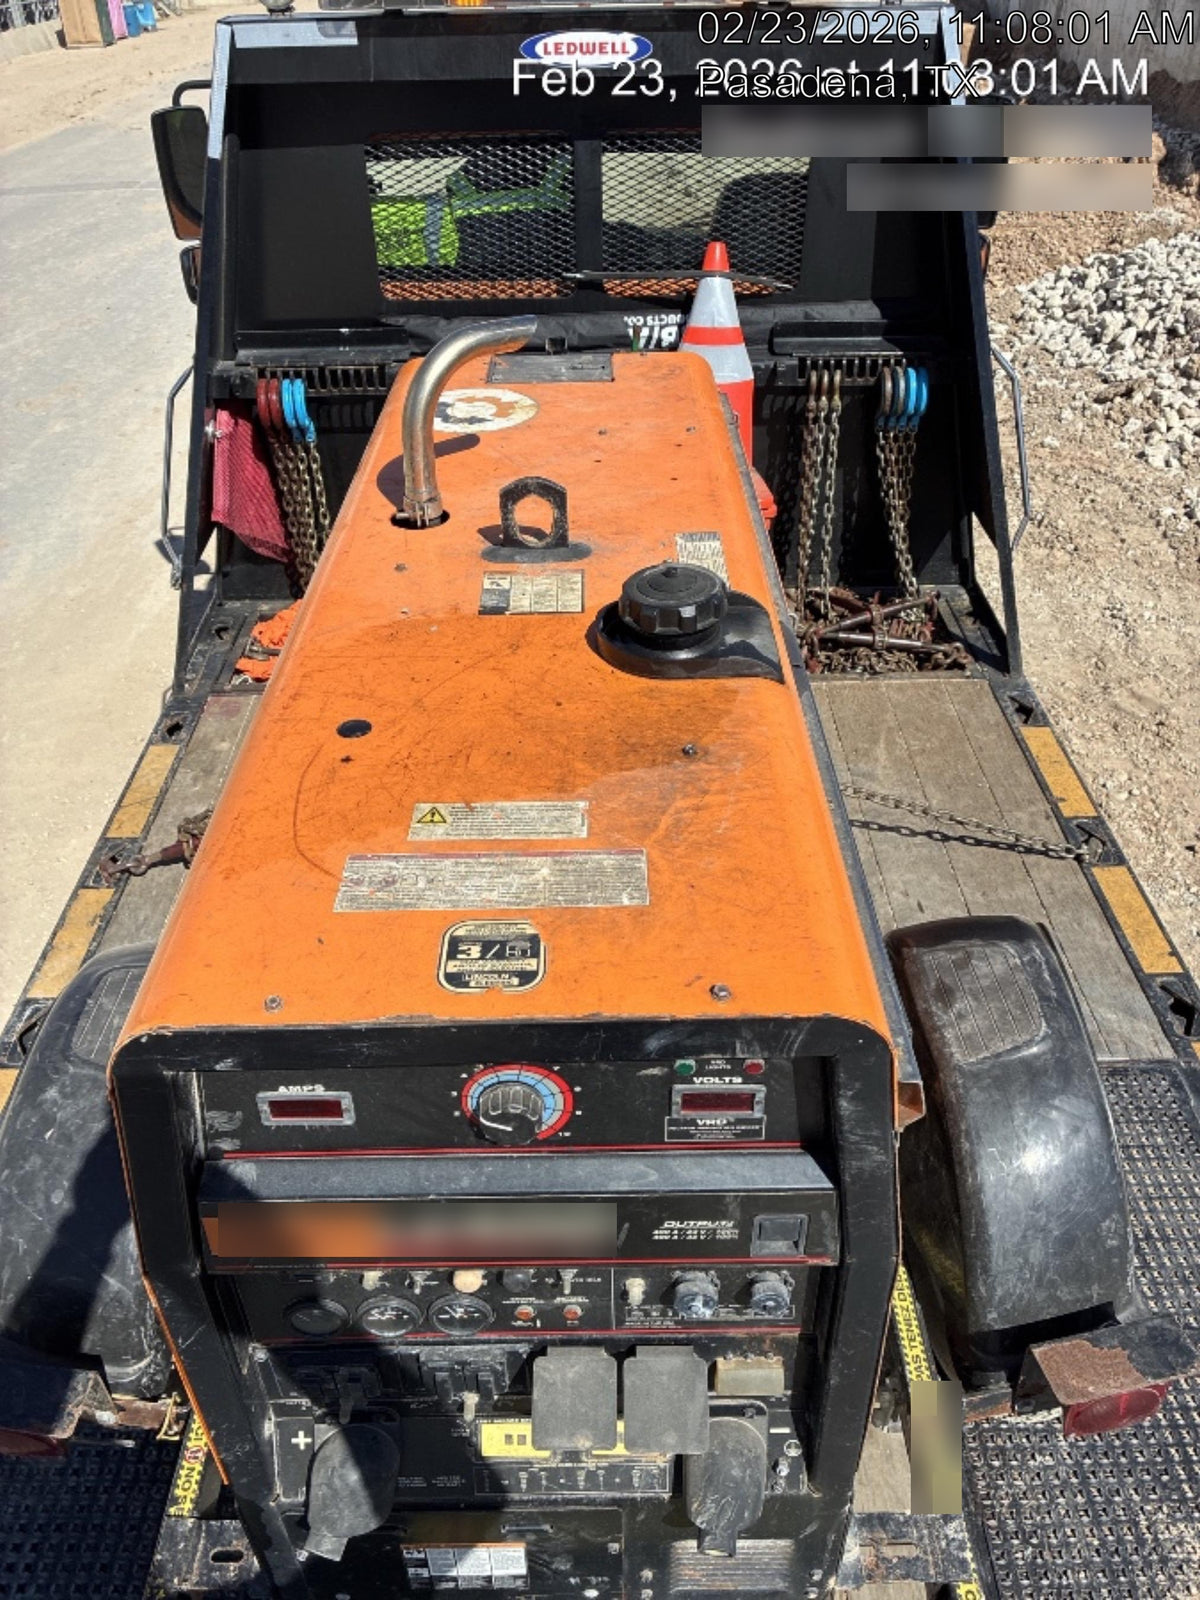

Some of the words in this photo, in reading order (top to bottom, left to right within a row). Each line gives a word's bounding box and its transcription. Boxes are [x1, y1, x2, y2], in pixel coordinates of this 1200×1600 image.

[543, 41, 631, 57] LEDWELL
[693, 1076, 743, 1084] VOLTS
[278, 1084, 326, 1093] AMPS
